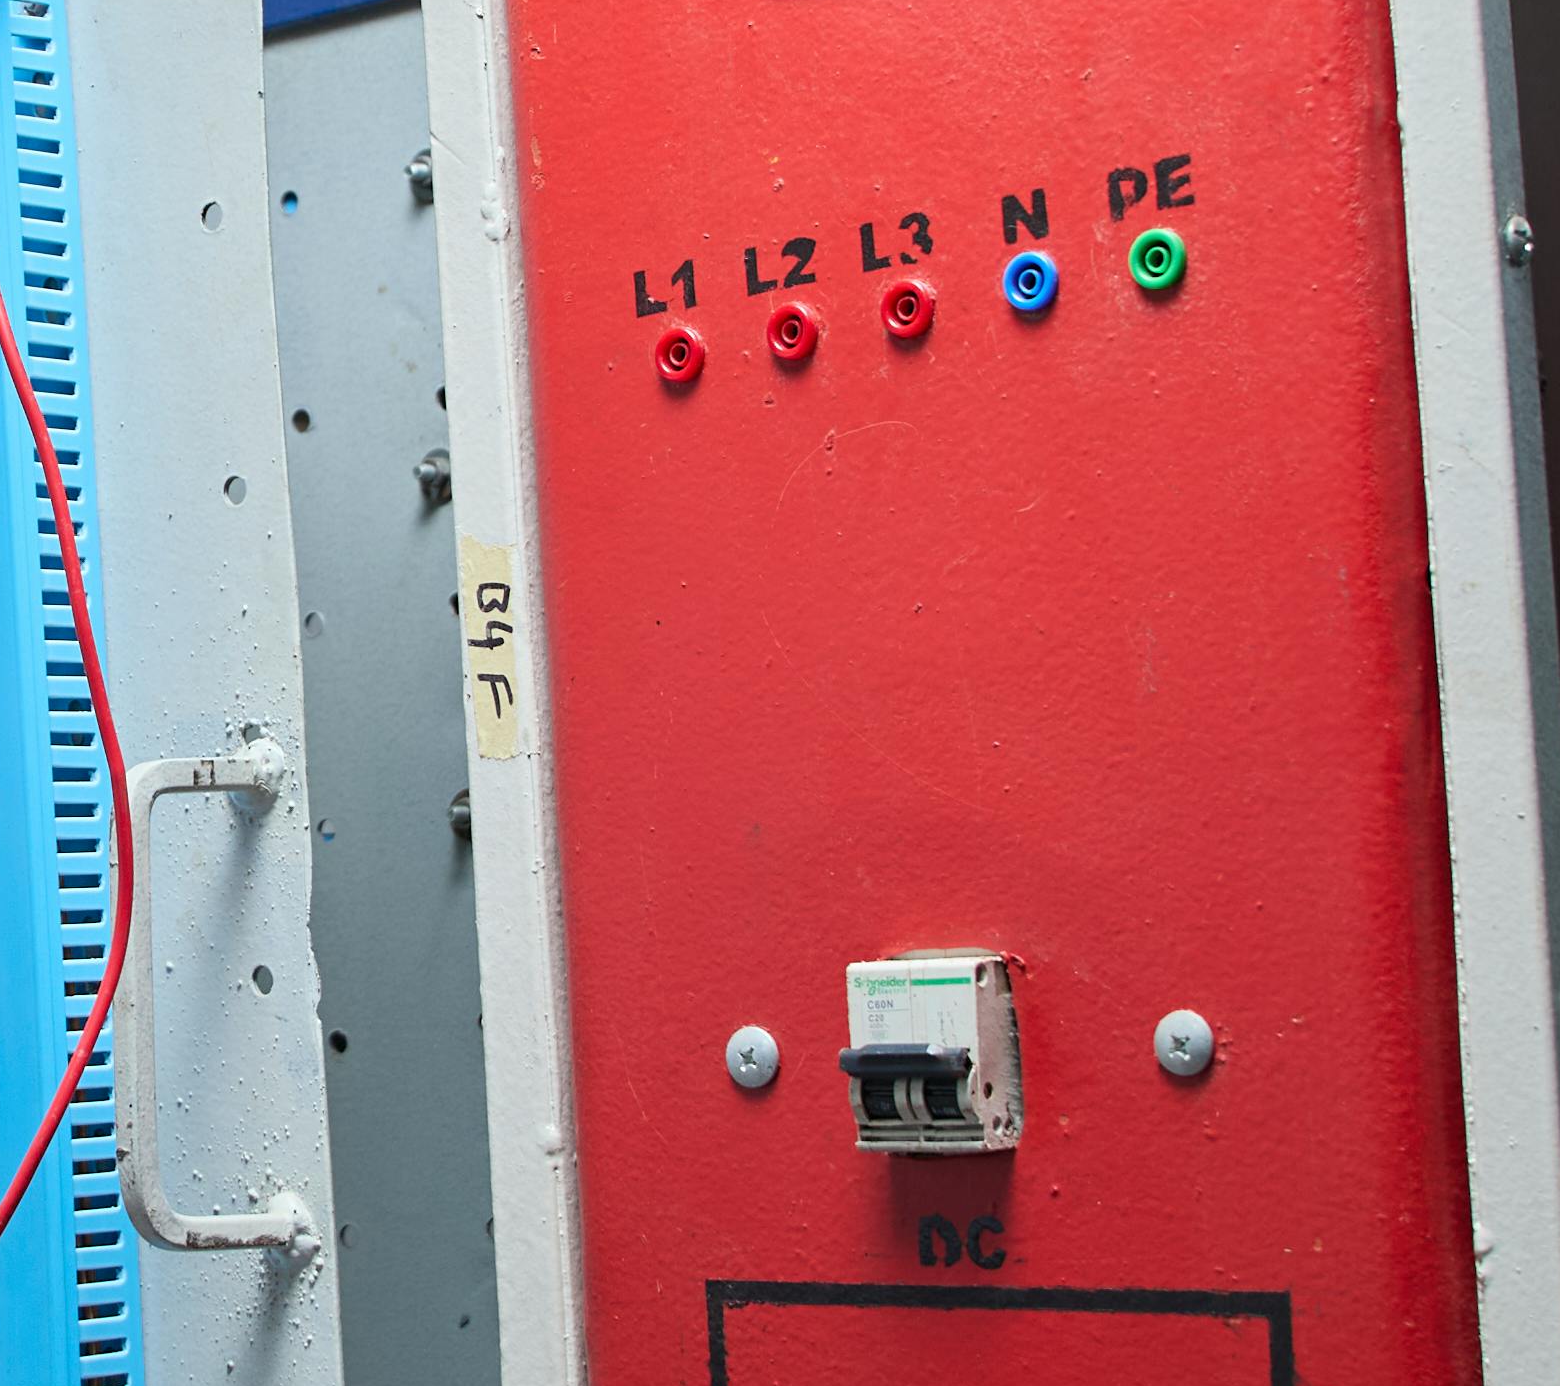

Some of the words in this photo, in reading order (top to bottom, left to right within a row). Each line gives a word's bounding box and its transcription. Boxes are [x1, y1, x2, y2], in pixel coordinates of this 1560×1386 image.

[1002, 189, 1048, 244] N
[1109, 154, 1195, 221] PE
[744, 237, 816, 295] L2
[860, 212, 933, 272] L3
[634, 260, 696, 317] L1
[866, 998, 894, 1010] C60N
[917, 1212, 1007, 1270] DC
